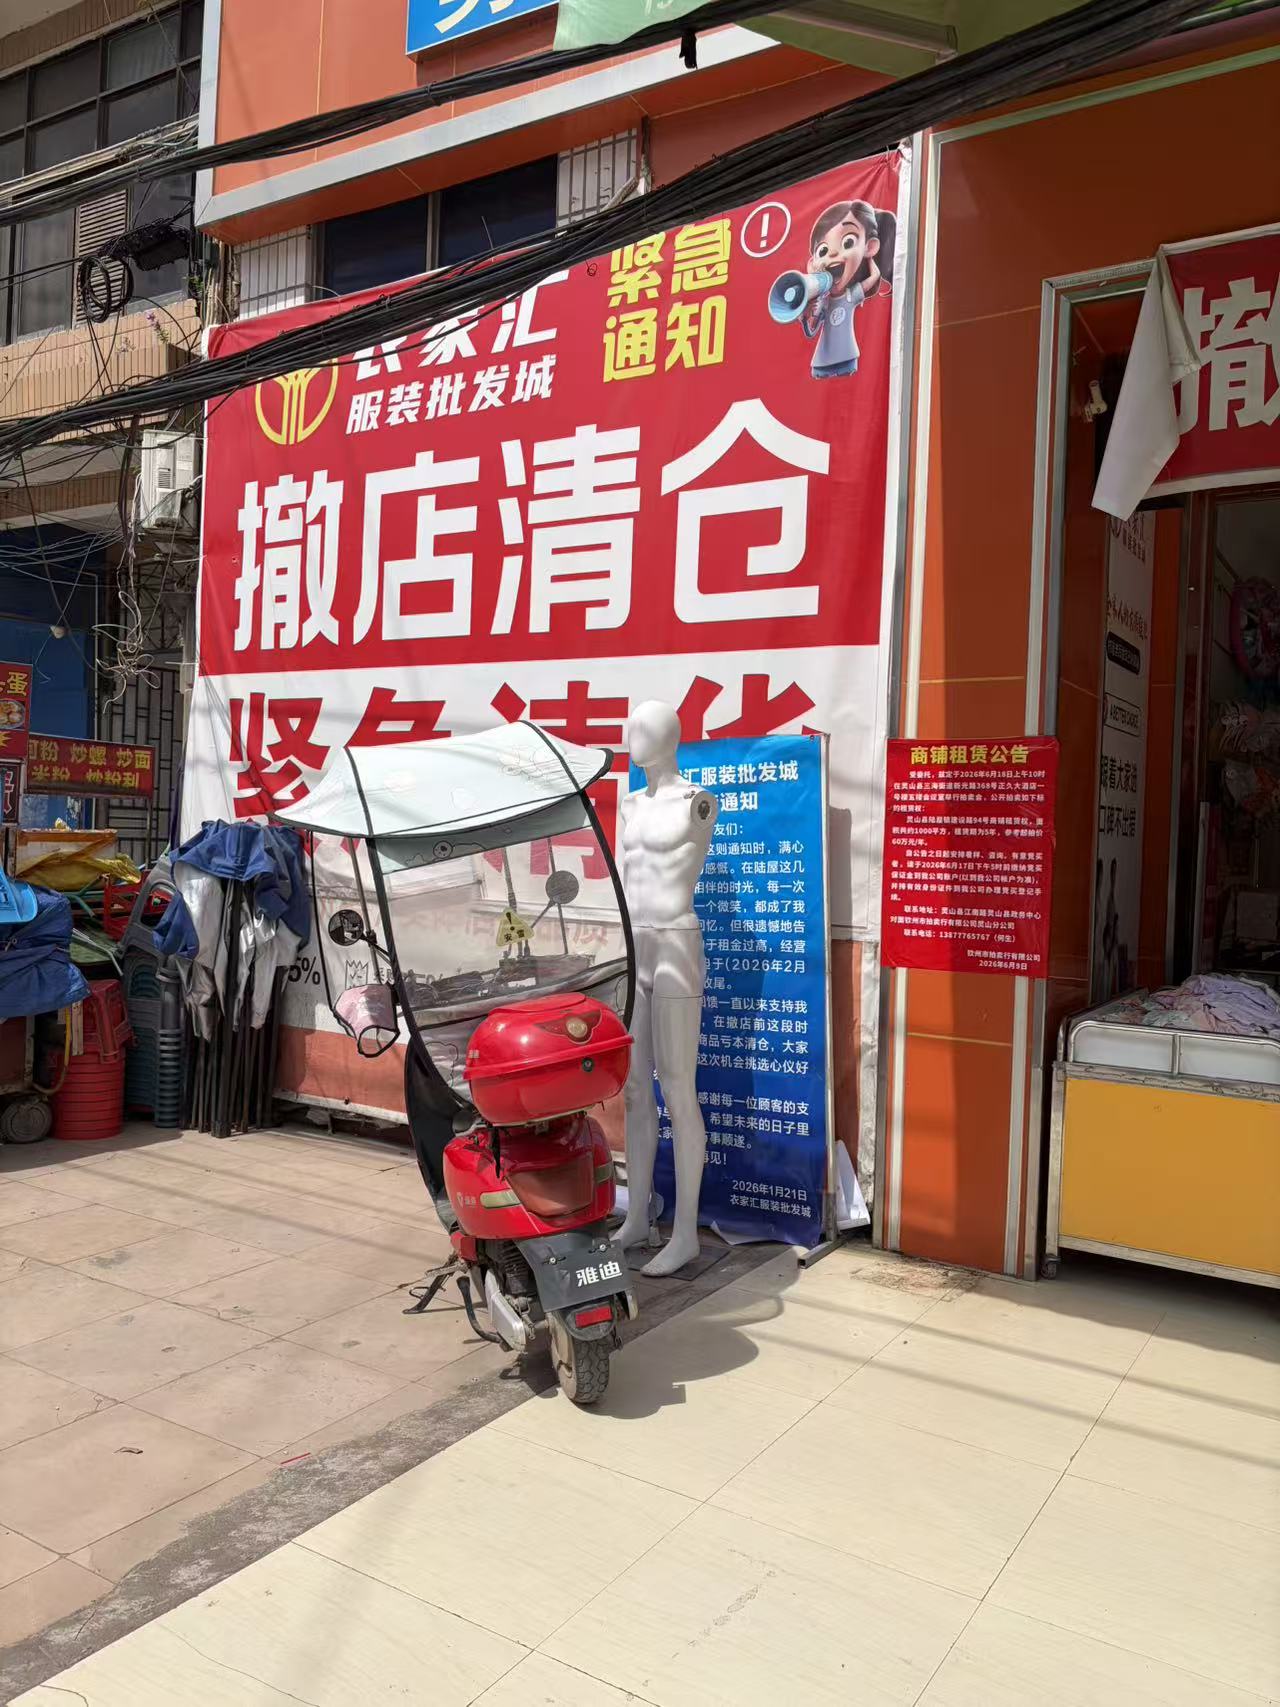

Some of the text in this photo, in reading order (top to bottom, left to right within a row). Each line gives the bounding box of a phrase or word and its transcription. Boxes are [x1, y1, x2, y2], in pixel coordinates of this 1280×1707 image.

[607, 218, 732, 308] 紧急
[603, 295, 728, 383] 通知
[346, 355, 557, 435] 服装批发城
[233, 397, 831, 653] 撤店清仓
[117, 748, 151, 770] 炒面
[910, 744, 1030, 765] 商铺租赁公告
[680, 759, 799, 787] 汇服装批发城
[715, 791, 758, 813] 通知
[700, 860, 805, 875] 感慨。在陆屋这几
[703, 939, 806, 954] 于租金过高，经营
[697, 1052, 809, 1076] 这次机会挑选心仪好
[698, 1090, 809, 1117] 感谢每一位顾客的支
[710, 1111, 811, 1137] 希望未来的日子里
[731, 1179, 808, 1201] 2026年1月21日
[729, 1193, 812, 1219] 衣家汇服装批发城
[576, 1261, 623, 1288] 雅迪
